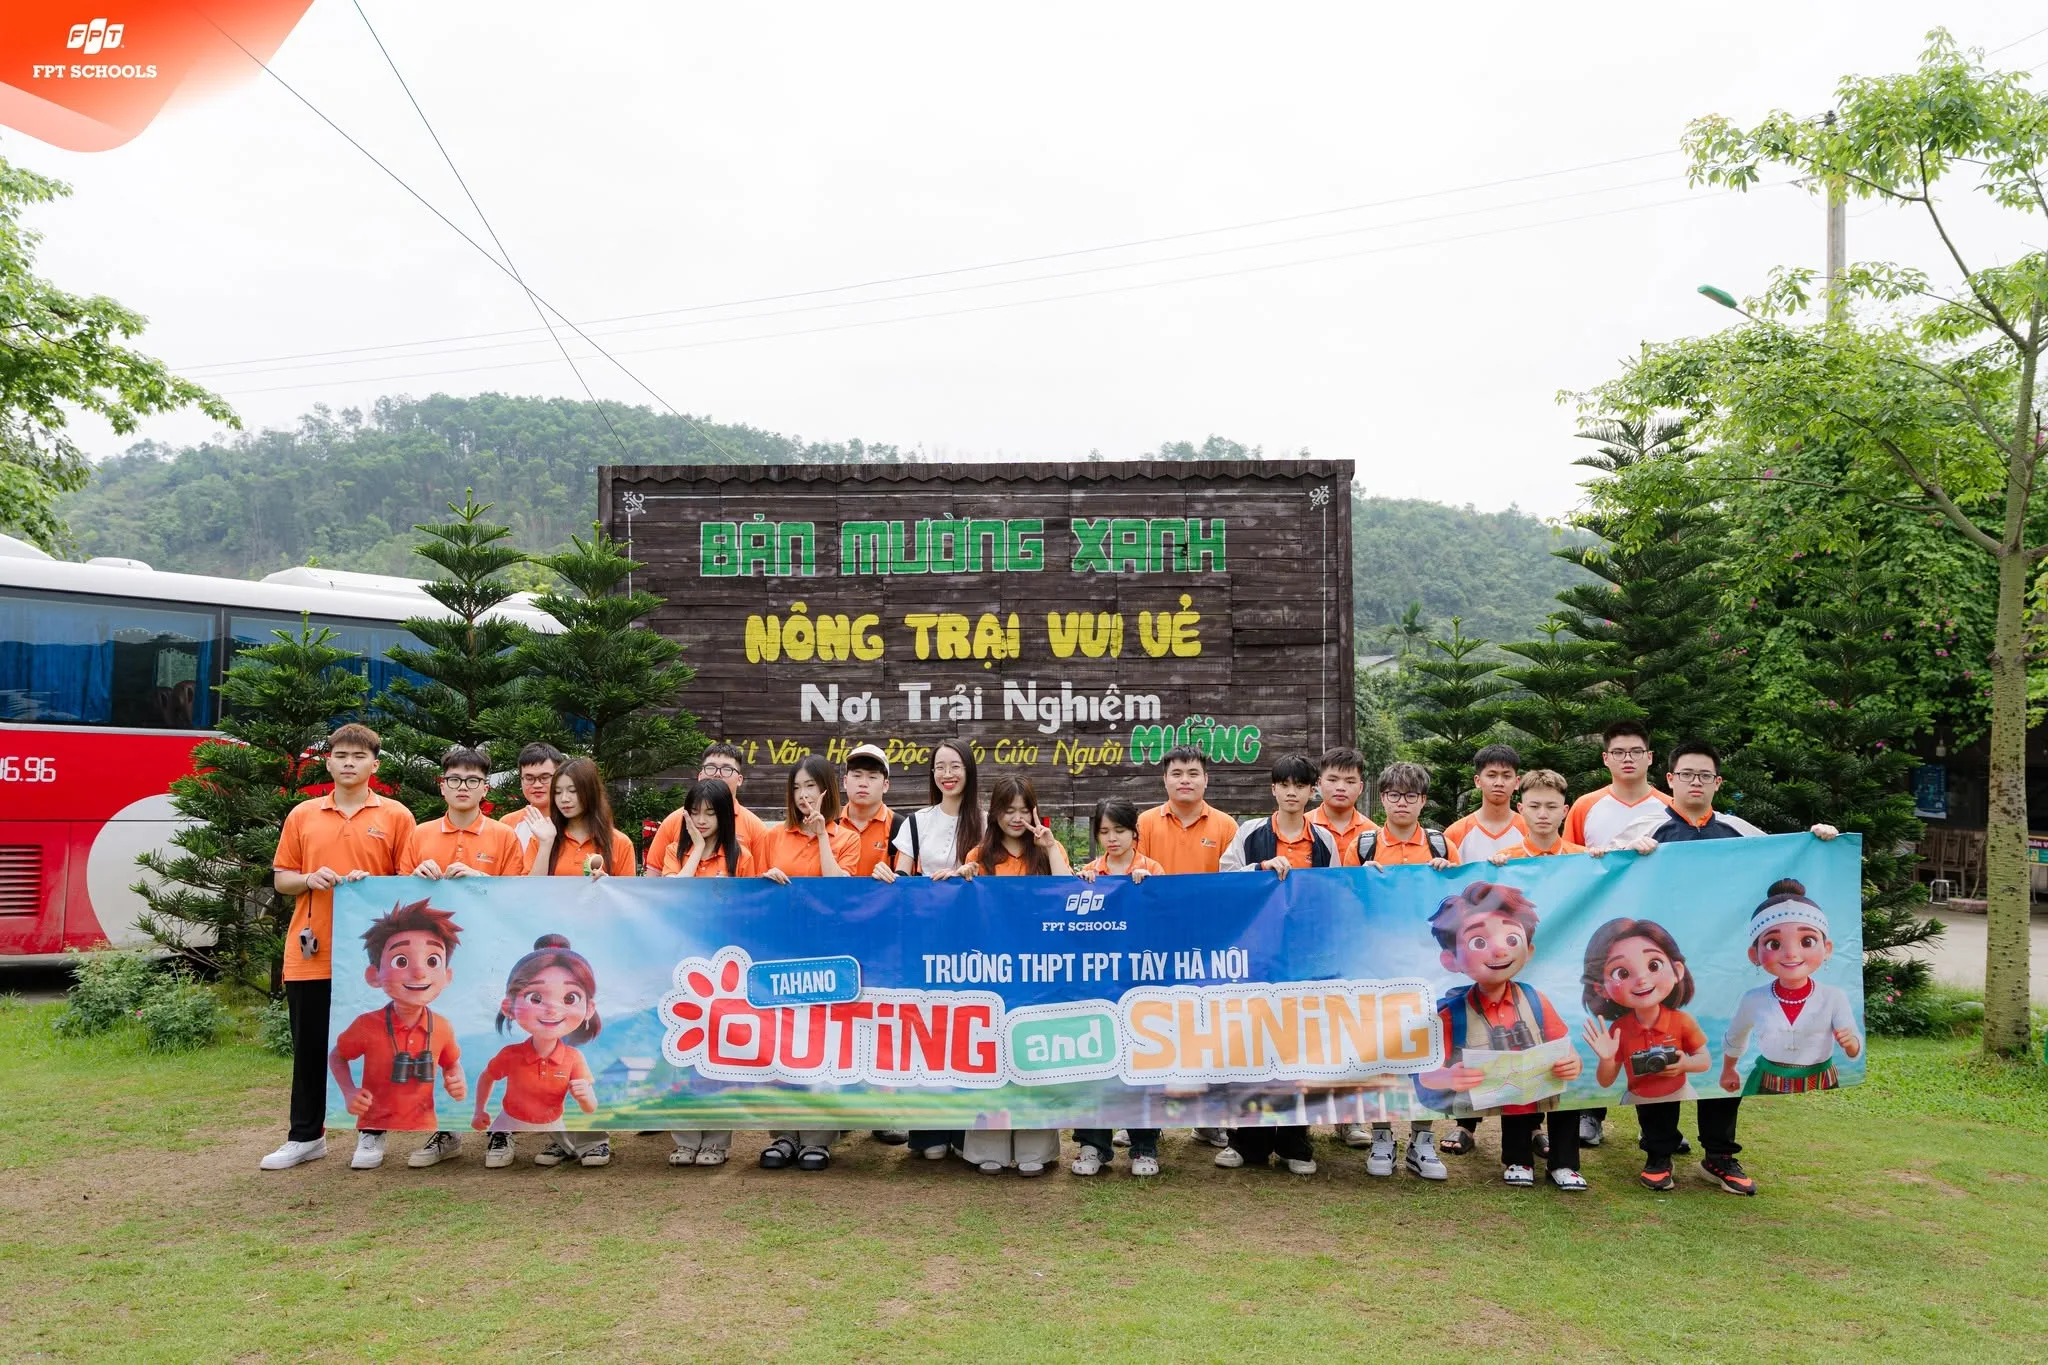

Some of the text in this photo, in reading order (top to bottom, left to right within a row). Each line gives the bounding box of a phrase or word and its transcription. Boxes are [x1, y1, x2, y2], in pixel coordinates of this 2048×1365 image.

[699, 512, 1228, 577] BẢN MƯỜNG XANH
[745, 601, 885, 664] NÔNG
[905, 611, 1021, 670] TRẠI
[1047, 611, 1124, 659] VUI
[800, 680, 1161, 735] Nơi Trải Nghiệm
[885, 737, 930, 771] Độc
[993, 738, 1039, 766] Của
[1052, 738, 1124, 775] Người
[1065, 890, 1105, 915] FPT
[1042, 921, 1127, 931] FPT SCHOOLS
[770, 969, 837, 996] TAHANO
[922, 946, 1249, 984] TRƯỜNG THPT FPT TÂY HÀ NỘI
[1026, 1019, 1104, 1064] and
